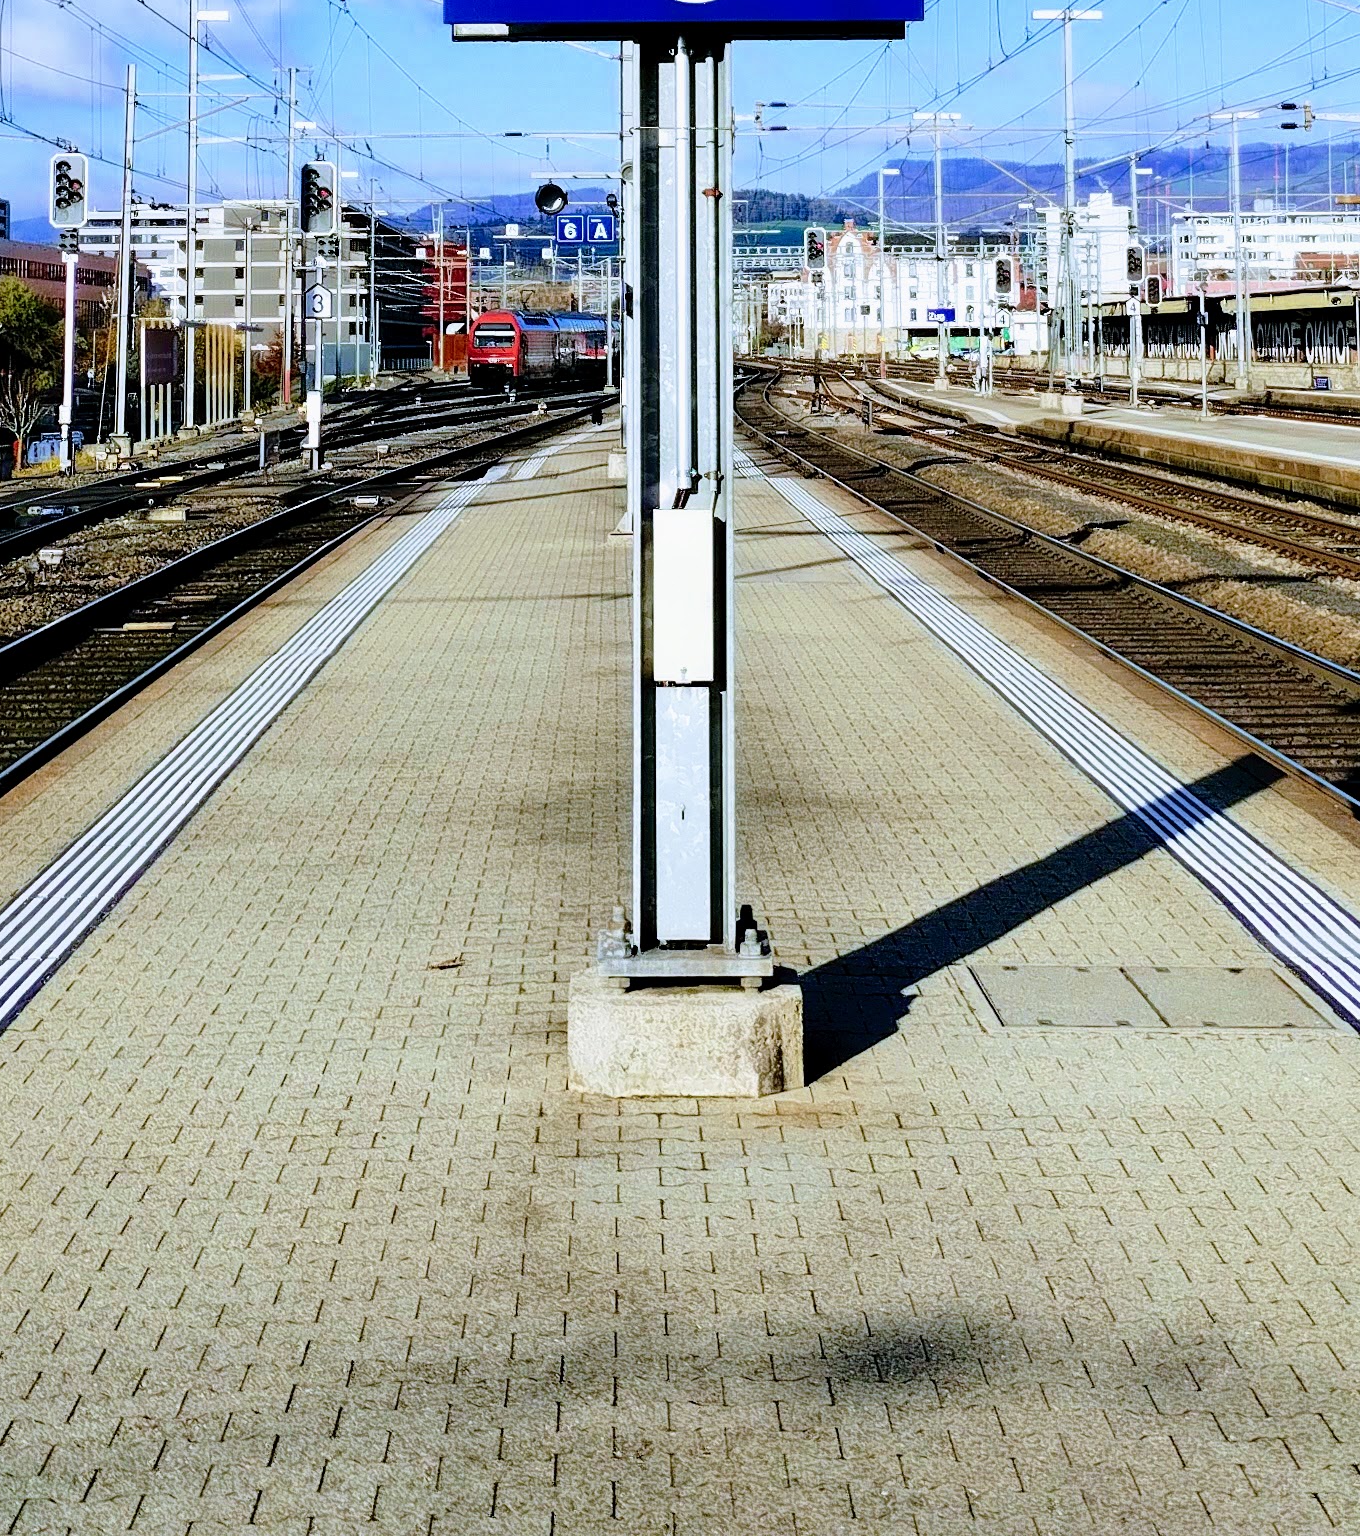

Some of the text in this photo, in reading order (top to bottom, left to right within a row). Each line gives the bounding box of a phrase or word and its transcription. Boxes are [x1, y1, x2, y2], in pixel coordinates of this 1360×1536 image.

[563, 222, 577, 240] 6
[593, 221, 608, 239] A
[311, 293, 324, 314] 3
[1129, 302, 1137, 313] 4
[998, 314, 1006, 325] 4
